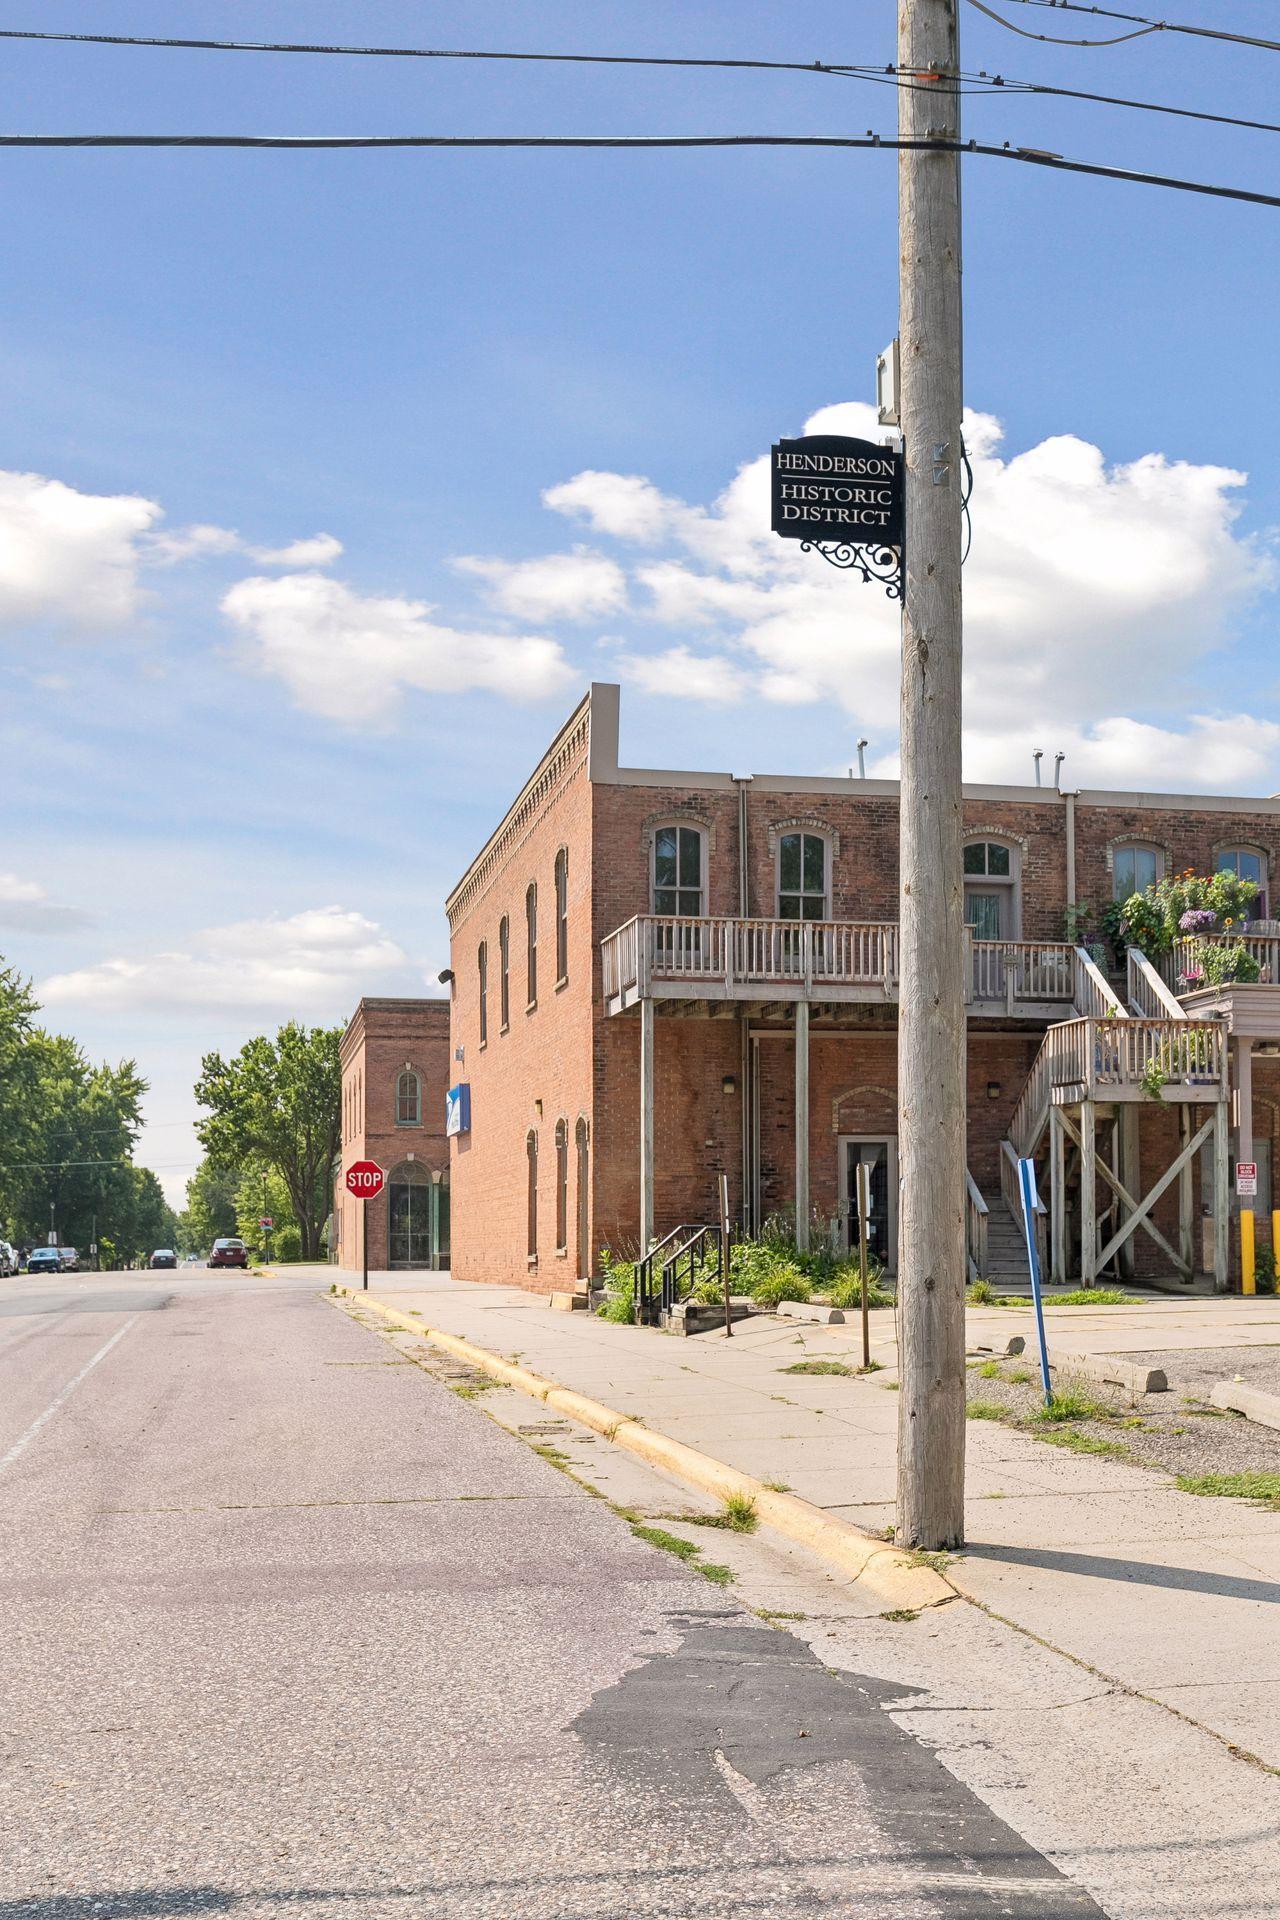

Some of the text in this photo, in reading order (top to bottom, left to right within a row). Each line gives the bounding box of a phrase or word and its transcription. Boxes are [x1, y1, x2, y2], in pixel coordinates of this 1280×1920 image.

[776, 453, 896, 476] HENDERSON
[780, 483, 892, 505] HISTORIC
[781, 504, 891, 526] DISTRICT
[348, 1172, 382, 1187] STOP
